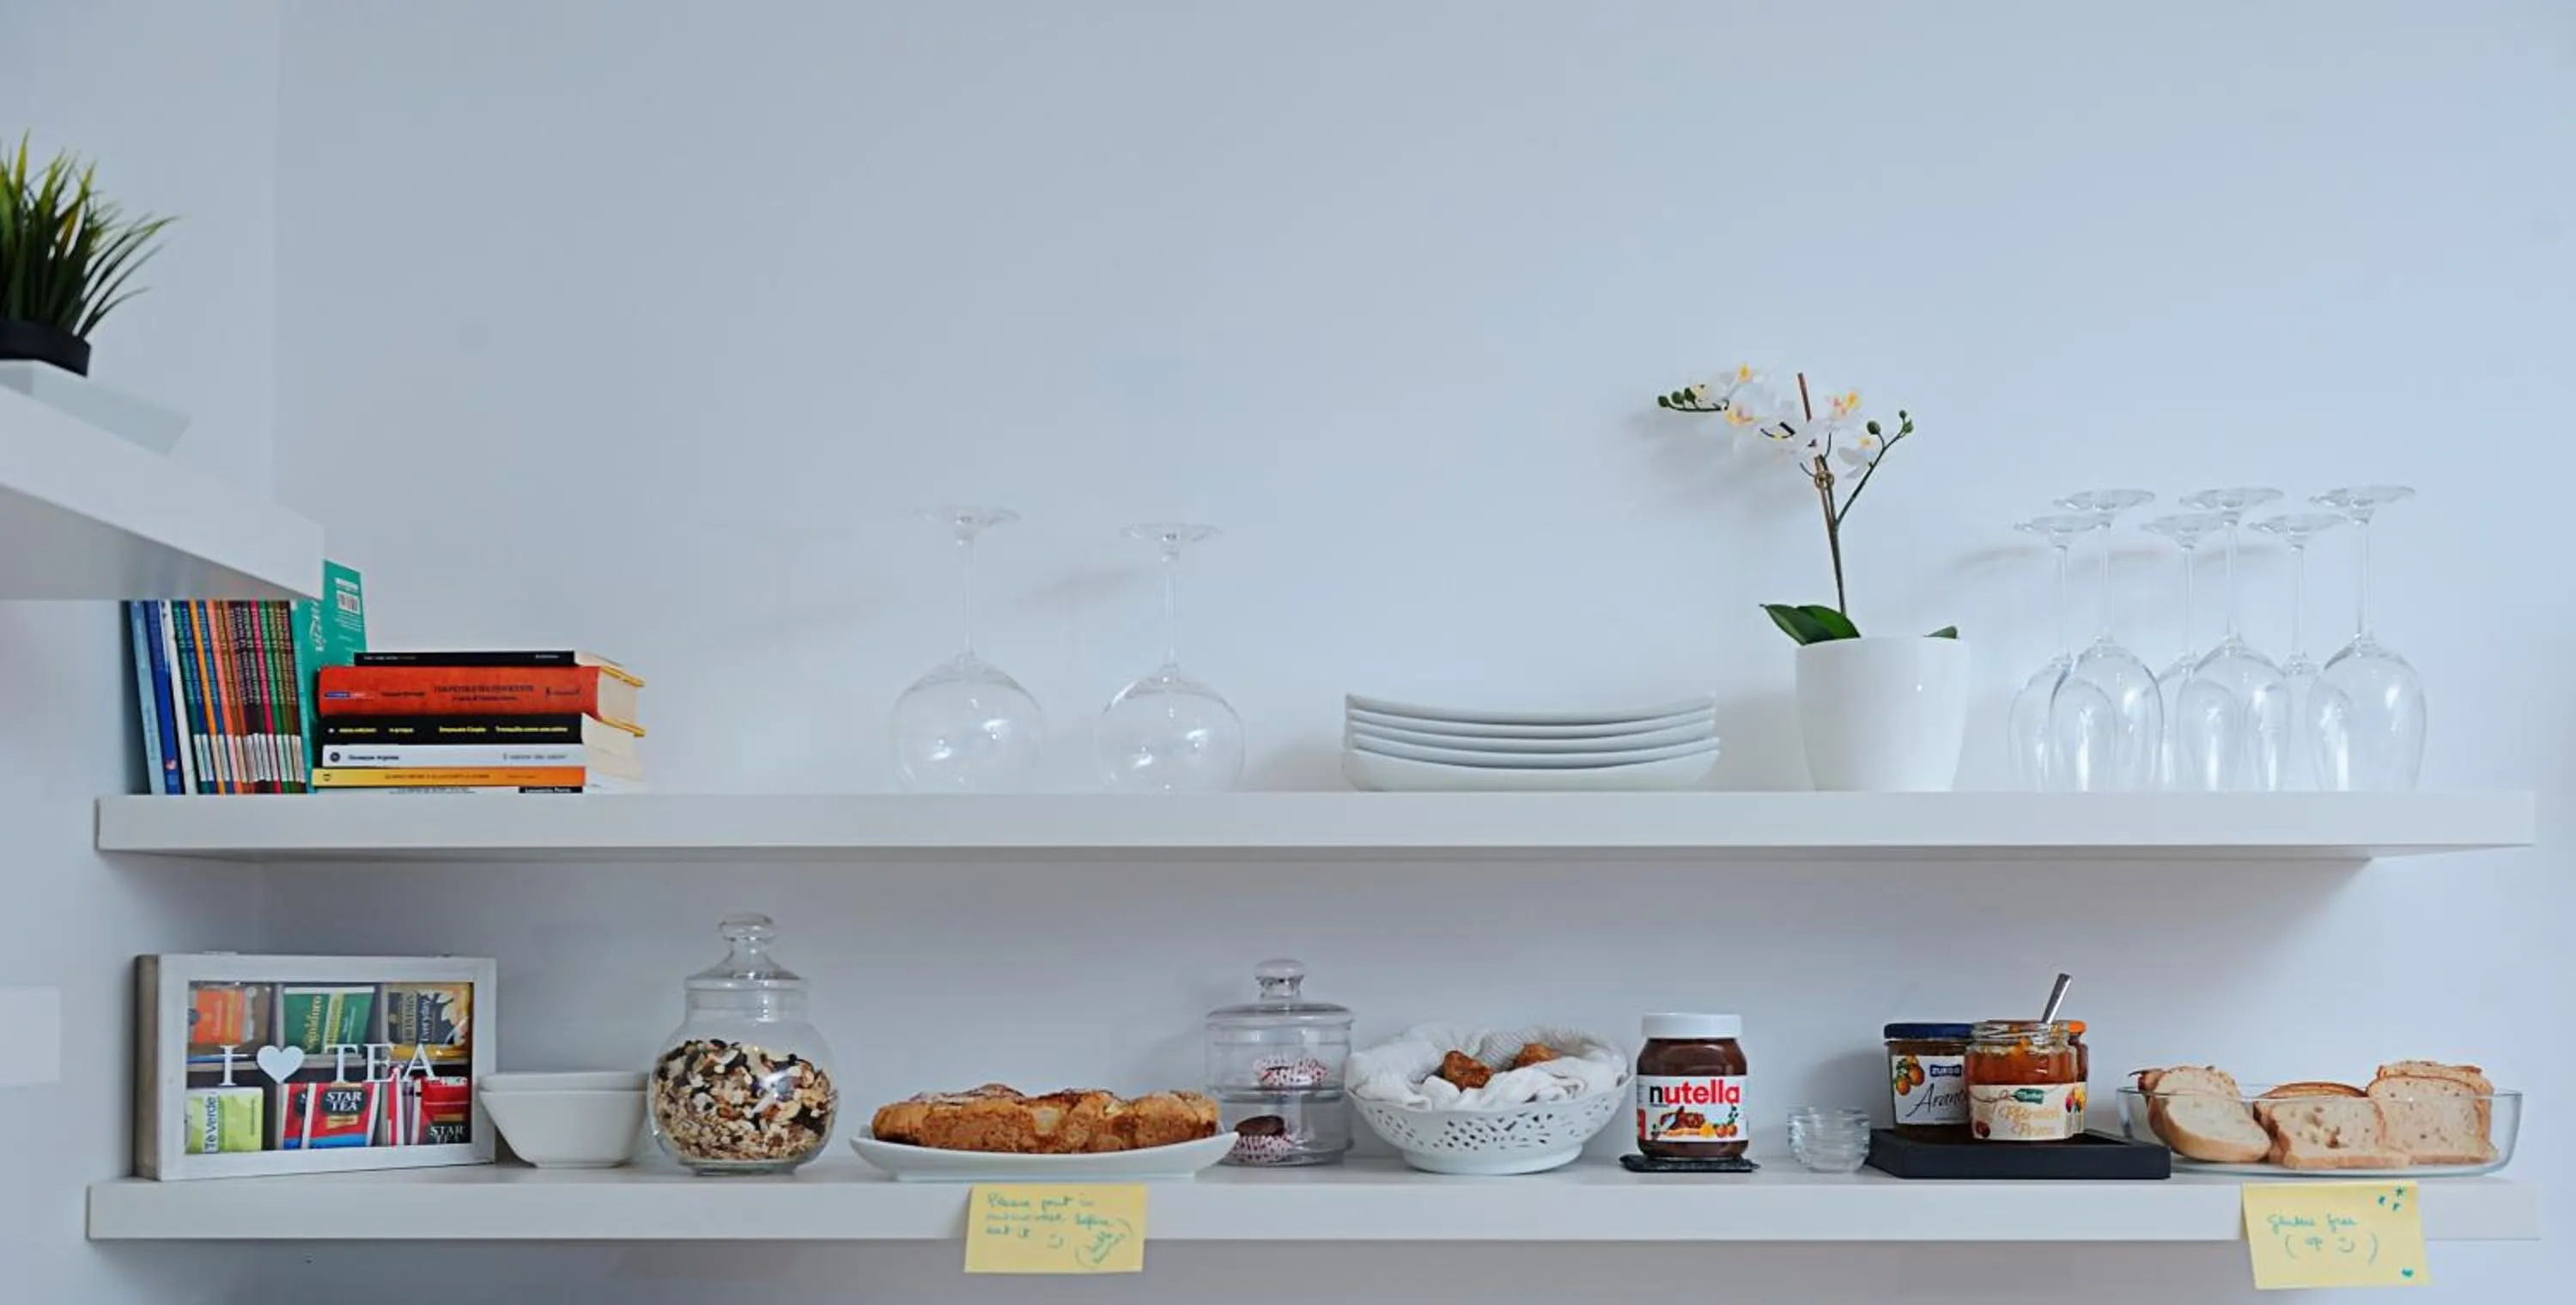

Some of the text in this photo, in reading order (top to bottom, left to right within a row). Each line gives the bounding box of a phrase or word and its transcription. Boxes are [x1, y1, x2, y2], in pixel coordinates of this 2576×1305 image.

[219, 1043, 439, 1086] I TEA
[325, 1091, 362, 1102] STAR
[1649, 1078, 1741, 1104] nutella
[331, 1099, 358, 1112] TEA
[429, 1125, 465, 1136] STAR
